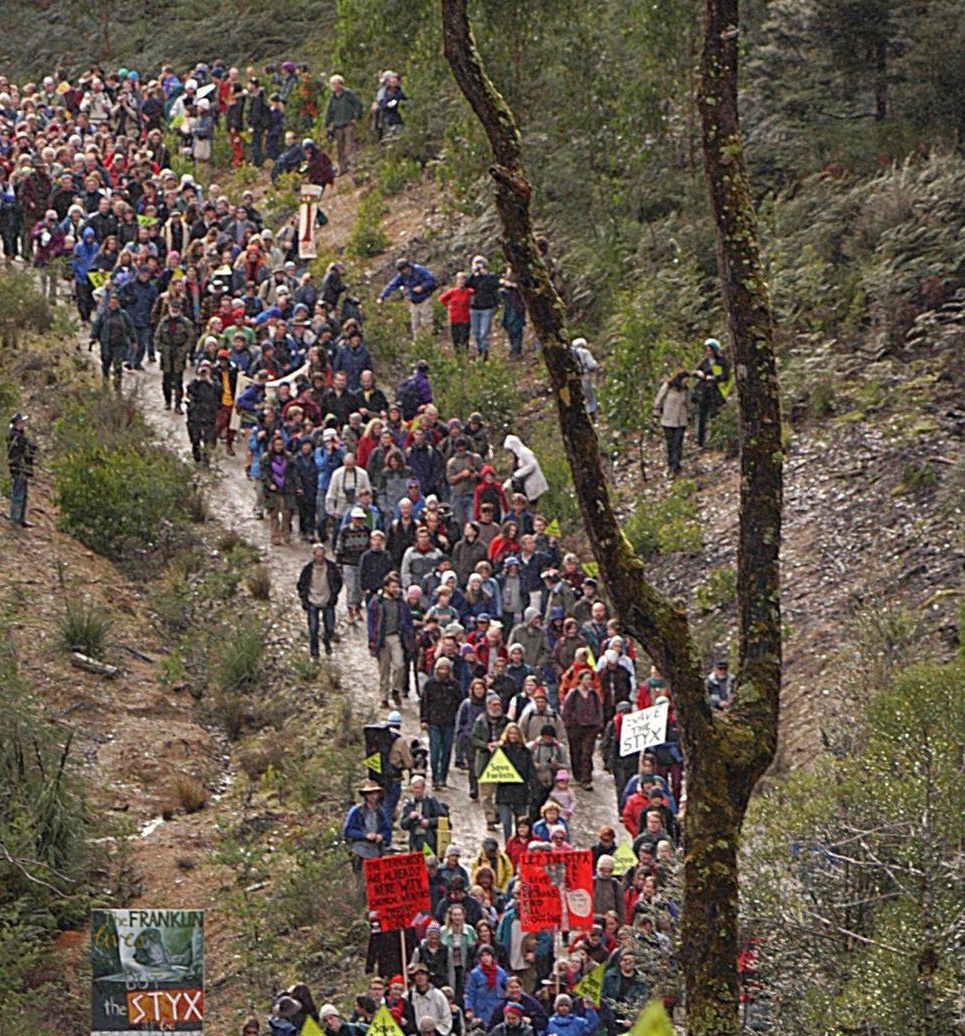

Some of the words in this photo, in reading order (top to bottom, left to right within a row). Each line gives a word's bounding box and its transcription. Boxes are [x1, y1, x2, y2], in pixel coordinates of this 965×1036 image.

[623, 727, 662, 752] STYX
[486, 771, 515, 779] Forests
[129, 910, 203, 928] FRANKLIN
[104, 996, 126, 1016] the
[132, 991, 203, 1023] STYX
[372, 1021, 395, 1033] Save
